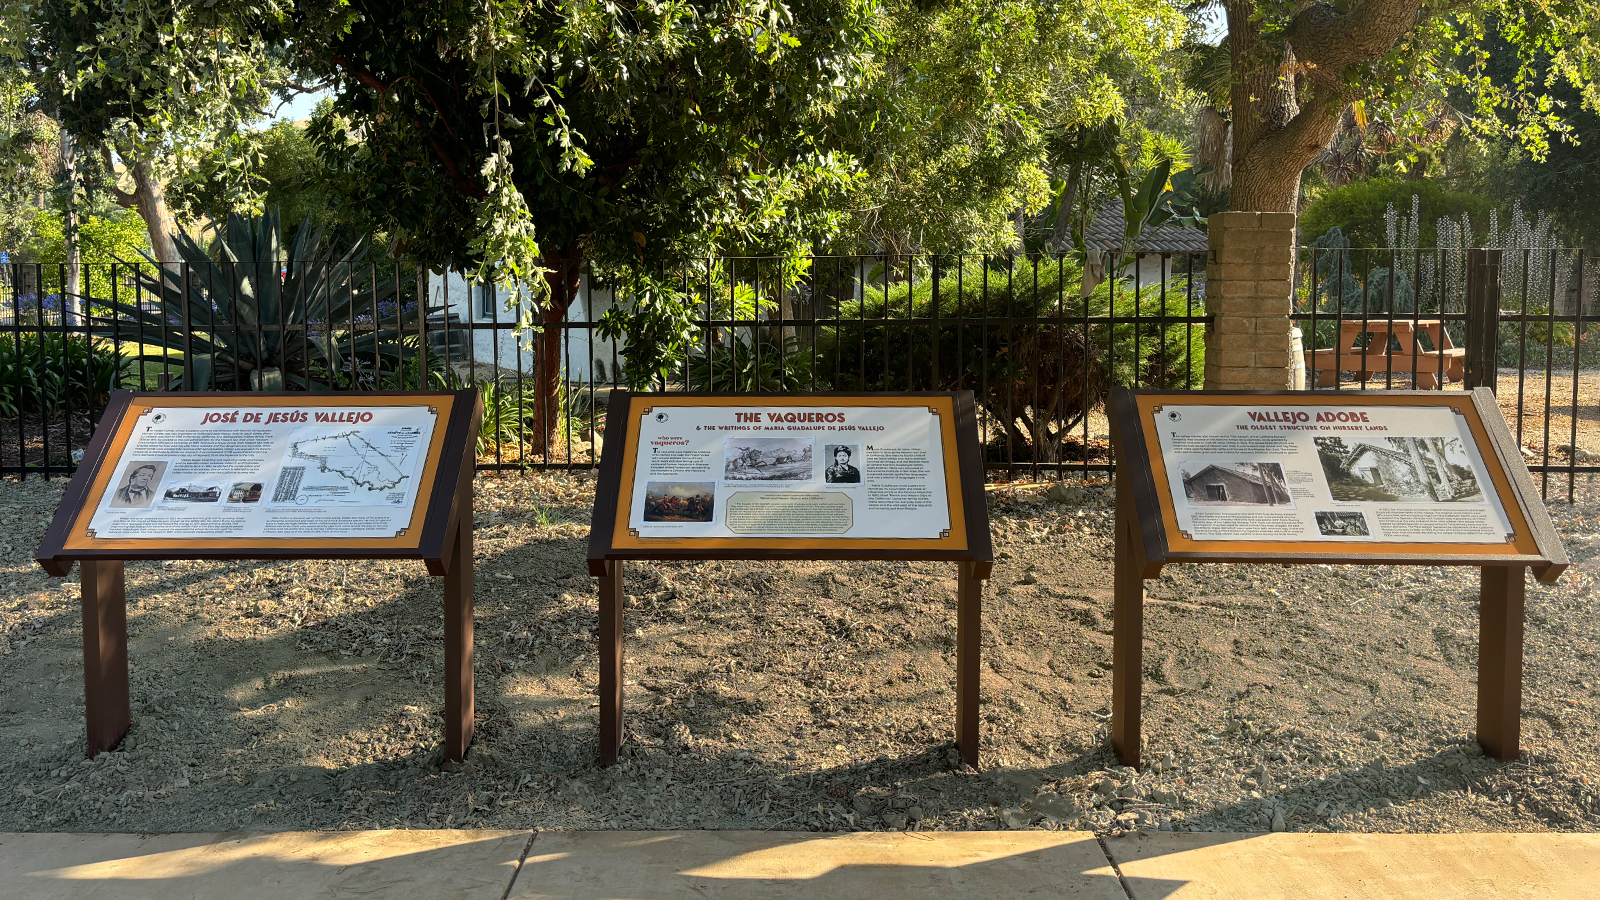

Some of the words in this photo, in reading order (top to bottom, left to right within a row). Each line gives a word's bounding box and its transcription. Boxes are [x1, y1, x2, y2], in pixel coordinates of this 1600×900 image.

[200, 410, 239, 425] JOSÉ
[242, 412, 263, 423] DE
[264, 410, 309, 425] JESÚS
[314, 411, 373, 425] VALLEJO
[734, 412, 762, 423] THE
[766, 412, 846, 424] VAQUEROS
[1247, 411, 1310, 424] VALLEJO
[1316, 411, 1370, 423] ADOBE
